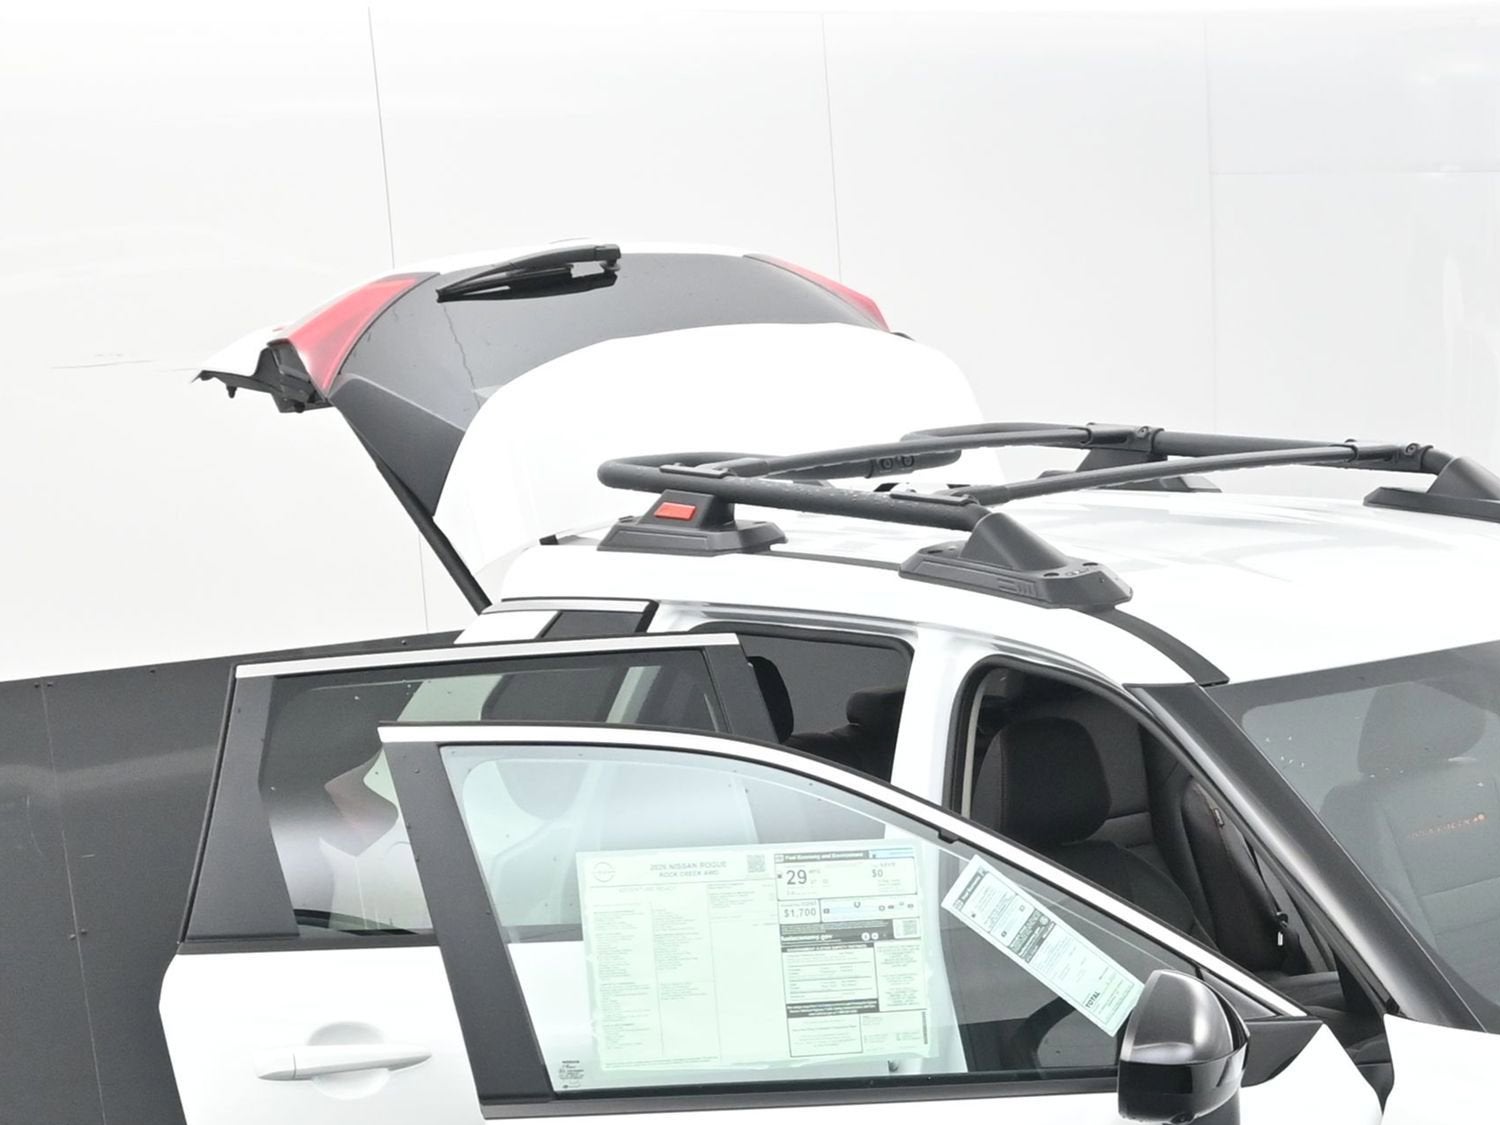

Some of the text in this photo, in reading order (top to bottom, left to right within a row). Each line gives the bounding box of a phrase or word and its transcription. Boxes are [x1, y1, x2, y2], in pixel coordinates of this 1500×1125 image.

[786, 869, 807, 885] 29
[872, 868, 884, 878] $0
[784, 907, 816, 918] $1,700
